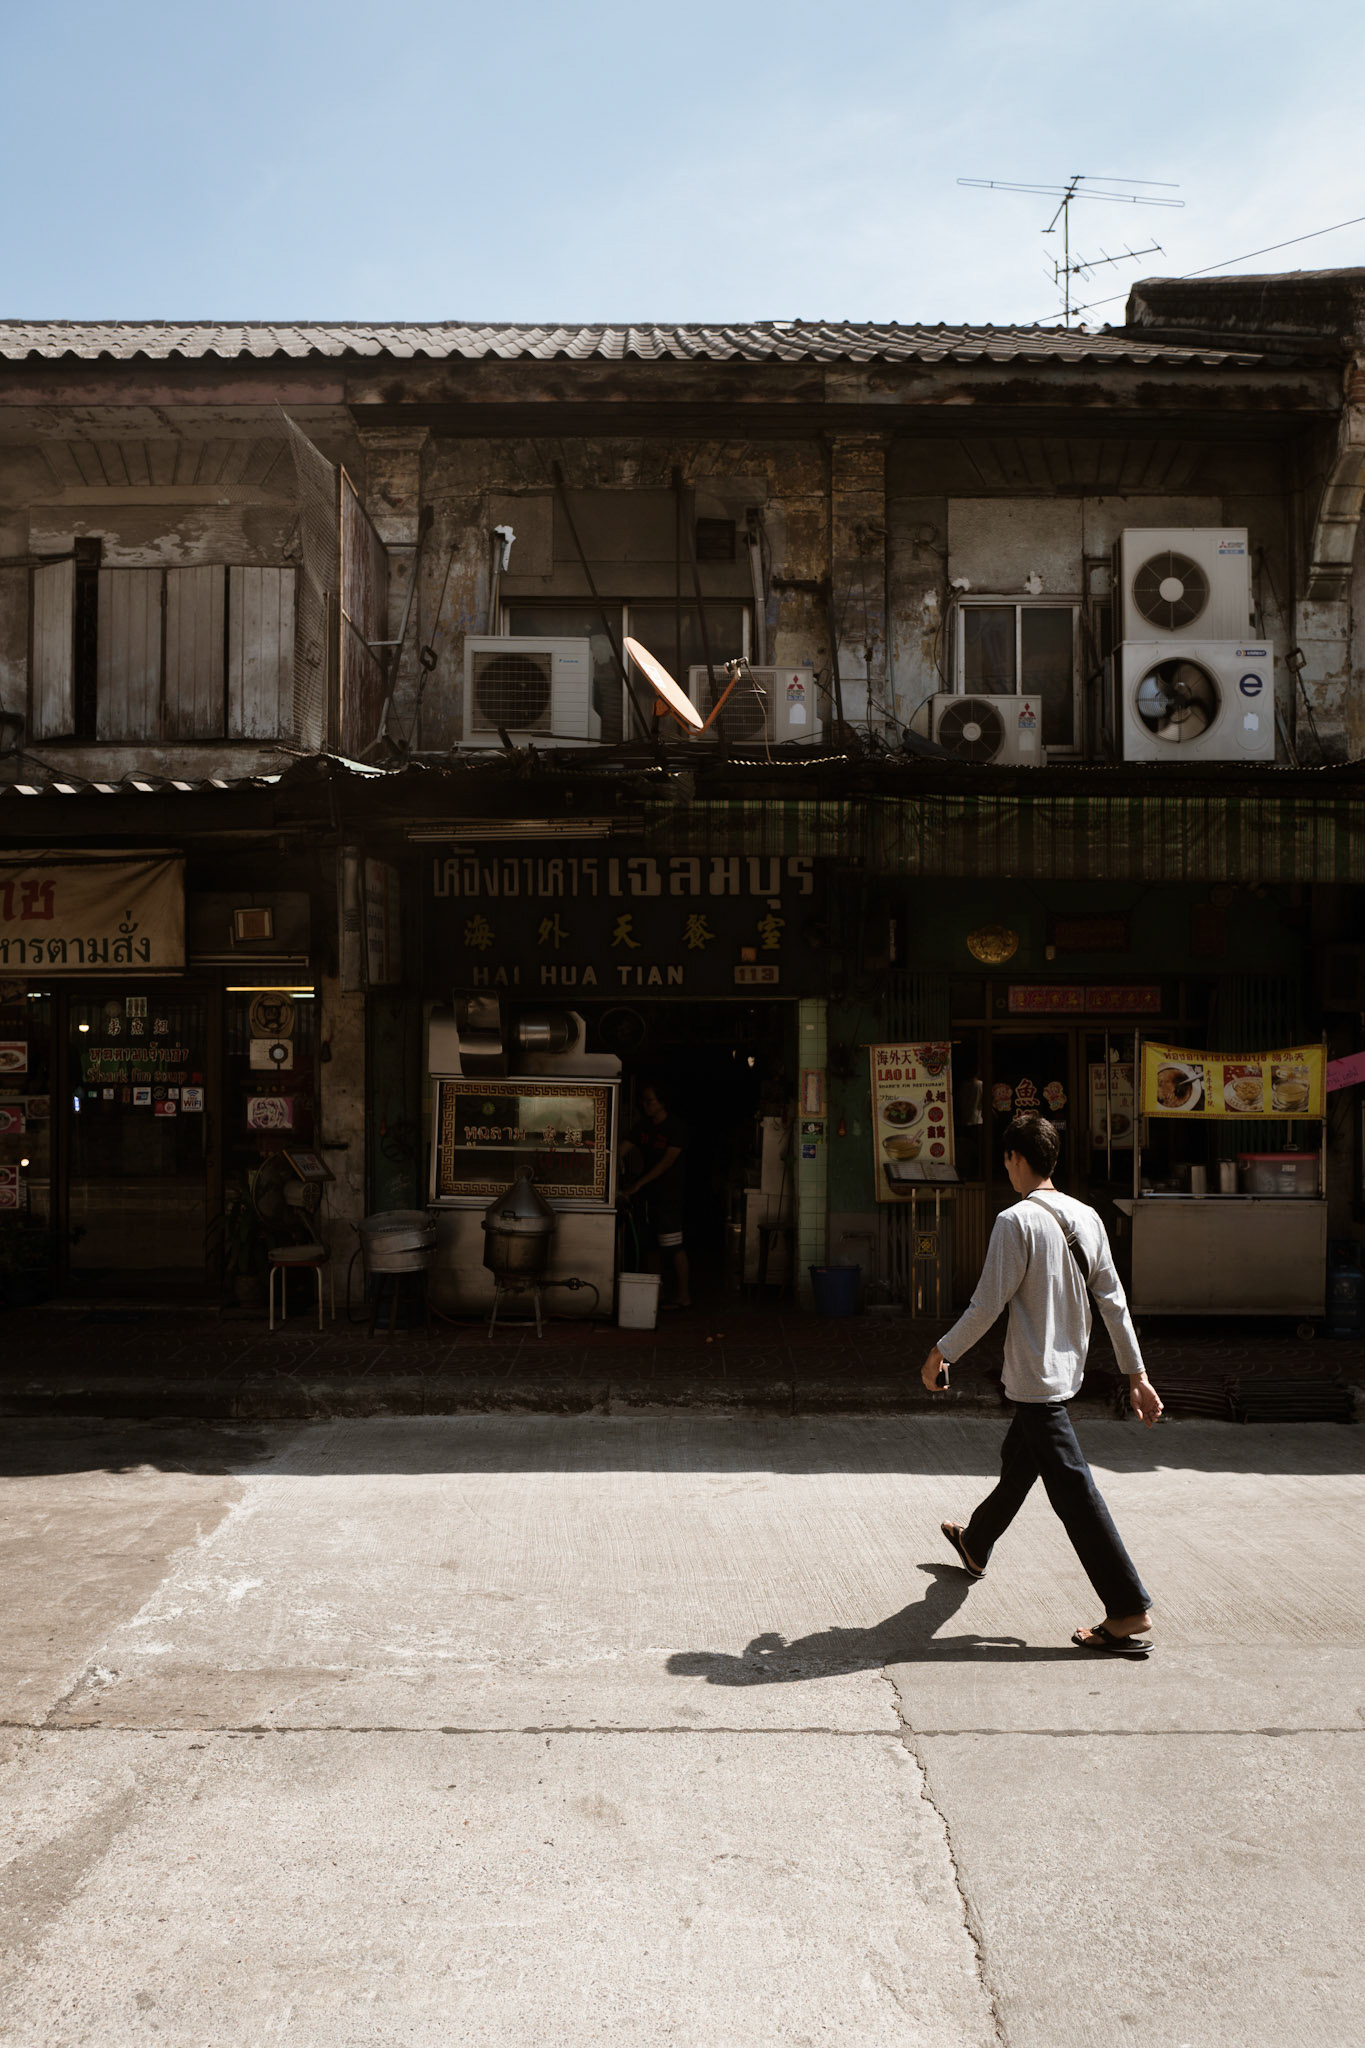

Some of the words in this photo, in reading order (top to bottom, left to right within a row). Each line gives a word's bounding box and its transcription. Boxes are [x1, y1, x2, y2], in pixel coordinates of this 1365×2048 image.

[472, 965, 521, 986] HAI
[540, 963, 599, 986] HUA
[616, 963, 685, 986] TIAN
[739, 967, 775, 982] 113
[876, 1049, 912, 1066] 海外天
[87, 1067, 129, 1083] Shark
[878, 1069, 902, 1081] LAO
[905, 1068, 916, 1081] LI
[464, 1125, 526, 1148] หูฉลาม
